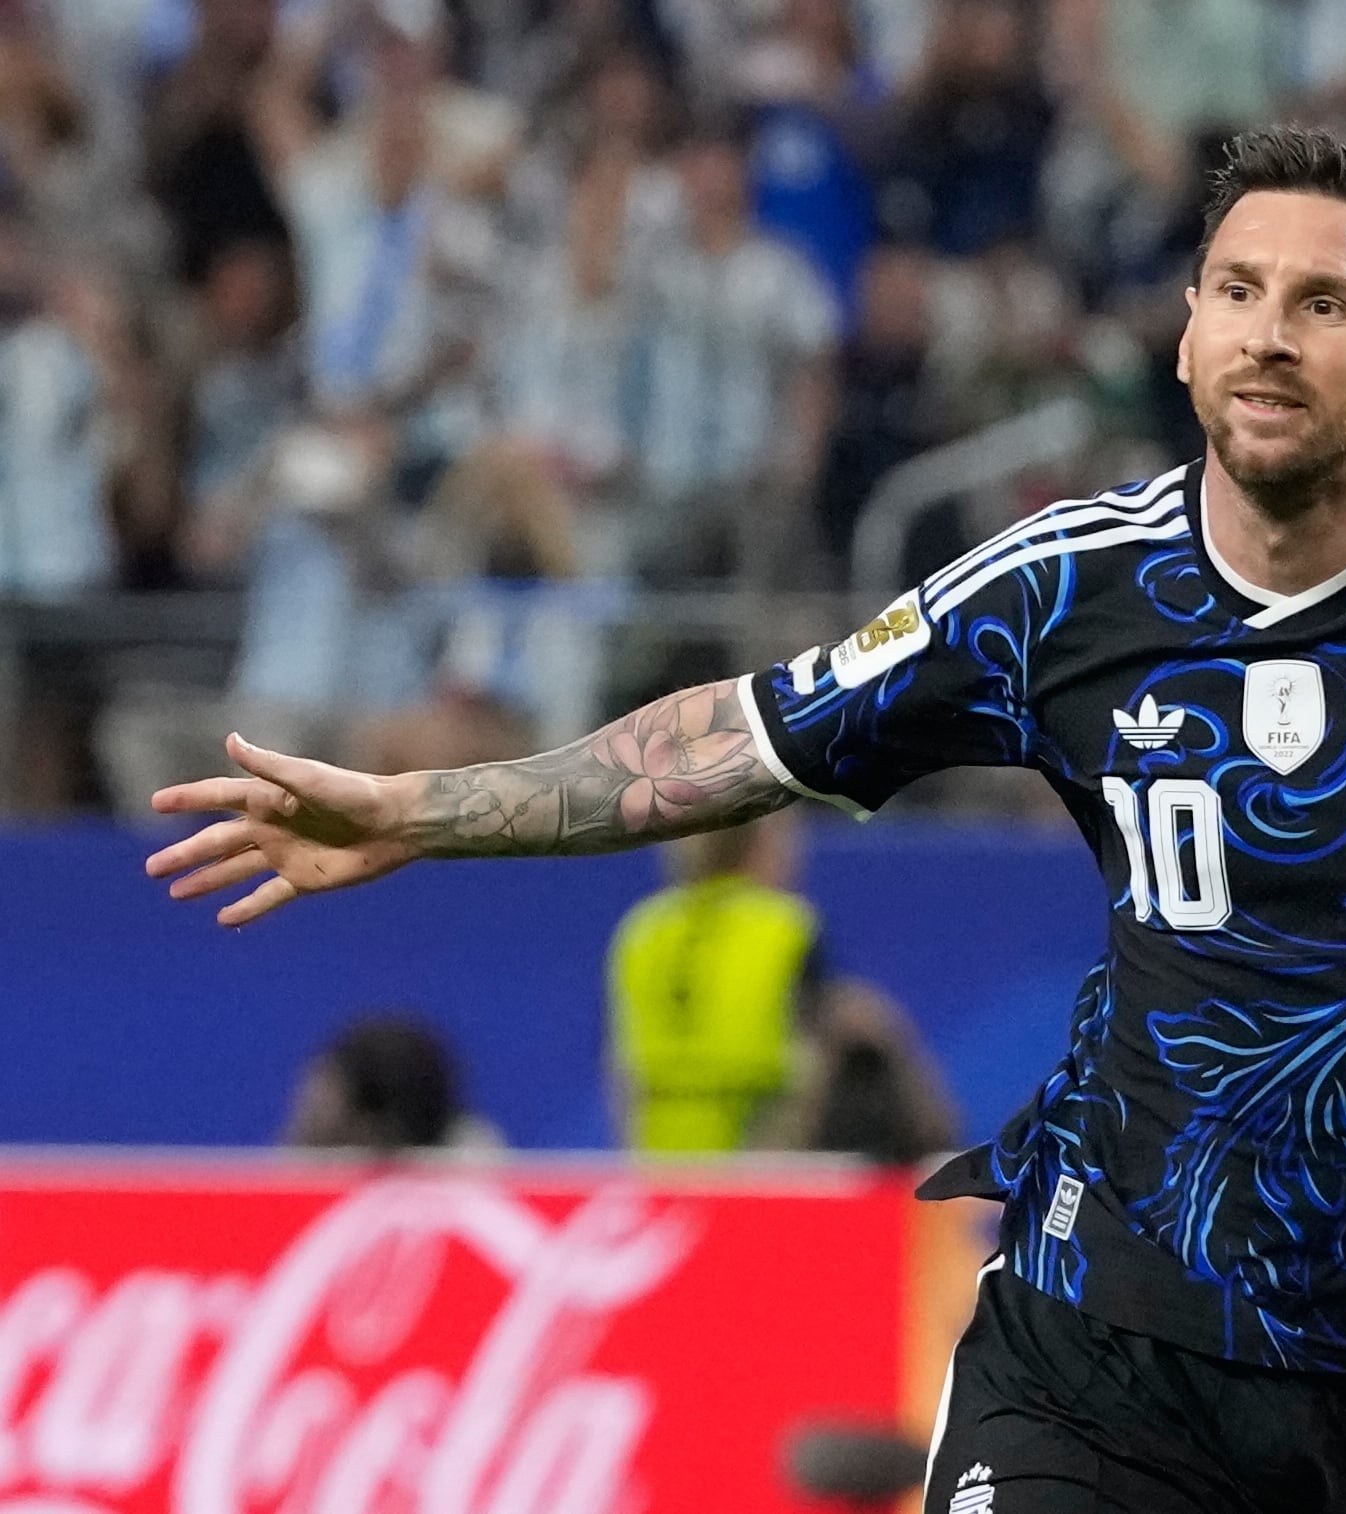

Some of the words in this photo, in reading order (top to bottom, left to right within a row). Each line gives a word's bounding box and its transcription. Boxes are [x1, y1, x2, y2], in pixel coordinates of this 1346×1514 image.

[1267, 732, 1301, 744] FIFA
[1273, 750, 1294, 758] 2022
[1101, 776, 1233, 931] 10
